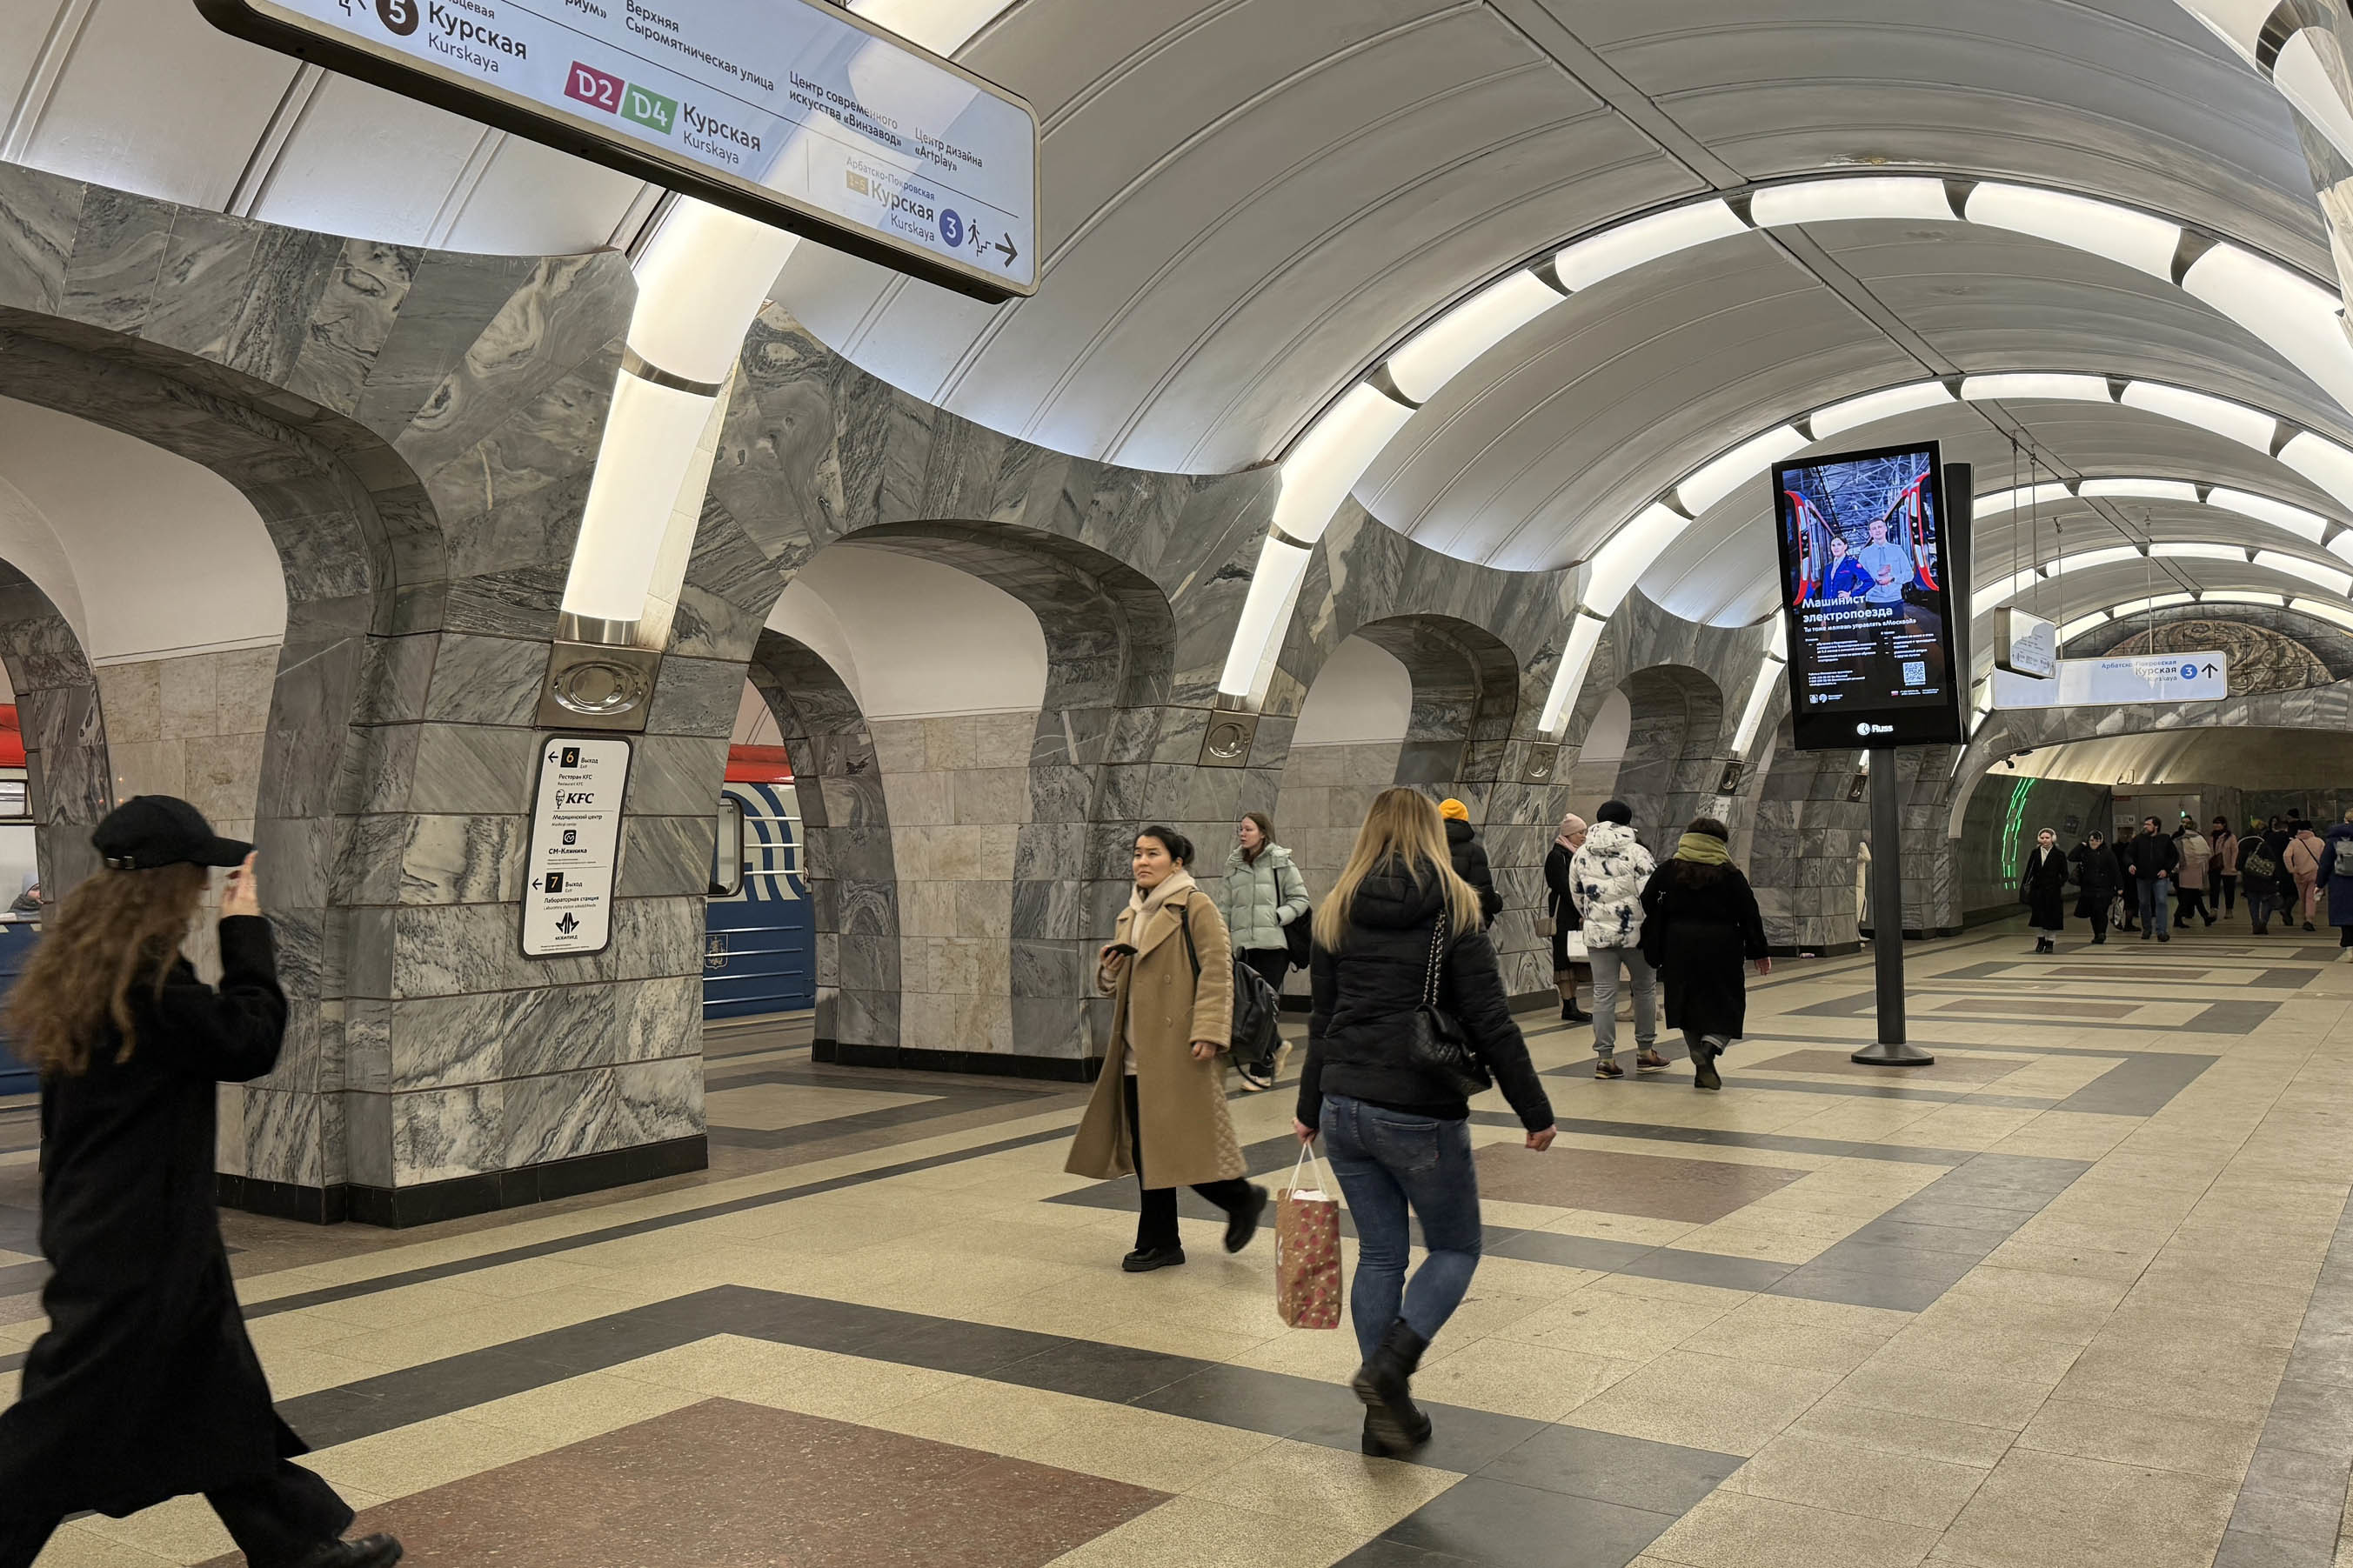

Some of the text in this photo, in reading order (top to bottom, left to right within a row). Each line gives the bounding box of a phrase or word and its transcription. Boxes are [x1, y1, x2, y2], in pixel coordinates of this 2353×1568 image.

[389, 0, 406, 24] 5
[626, 0, 679, 33] Верхняя
[429, 1, 527, 60] Курская
[428, 32, 499, 73] Kurskaya
[625, 17, 774, 91] Сыромятническая улица
[576, 69, 613, 106] D2
[790, 70, 899, 130] Центр современного
[632, 91, 668, 127] D4
[789, 90, 902, 147] искусства «Винзавод»
[684, 103, 761, 152] Курская
[684, 130, 739, 164] Kurskaya
[914, 145, 958, 172] «Artplay»
[915, 127, 983, 168] Центр дизайна
[846, 157, 935, 202] Арбатско-Покровская
[872, 180, 934, 223] Курская
[891, 213, 935, 243] Kurskaya
[946, 217, 957, 239] 3
[1802, 596, 1866, 609] Машинист
[1802, 607, 1893, 624] электропоезда
[2136, 667, 2177, 677] Курская
[2185, 667, 2193, 677] 3
[1871, 724, 1894, 733] Russ
[566, 751, 574, 764] 6
[565, 792, 594, 804] KFC
[551, 876, 558, 889] 7
